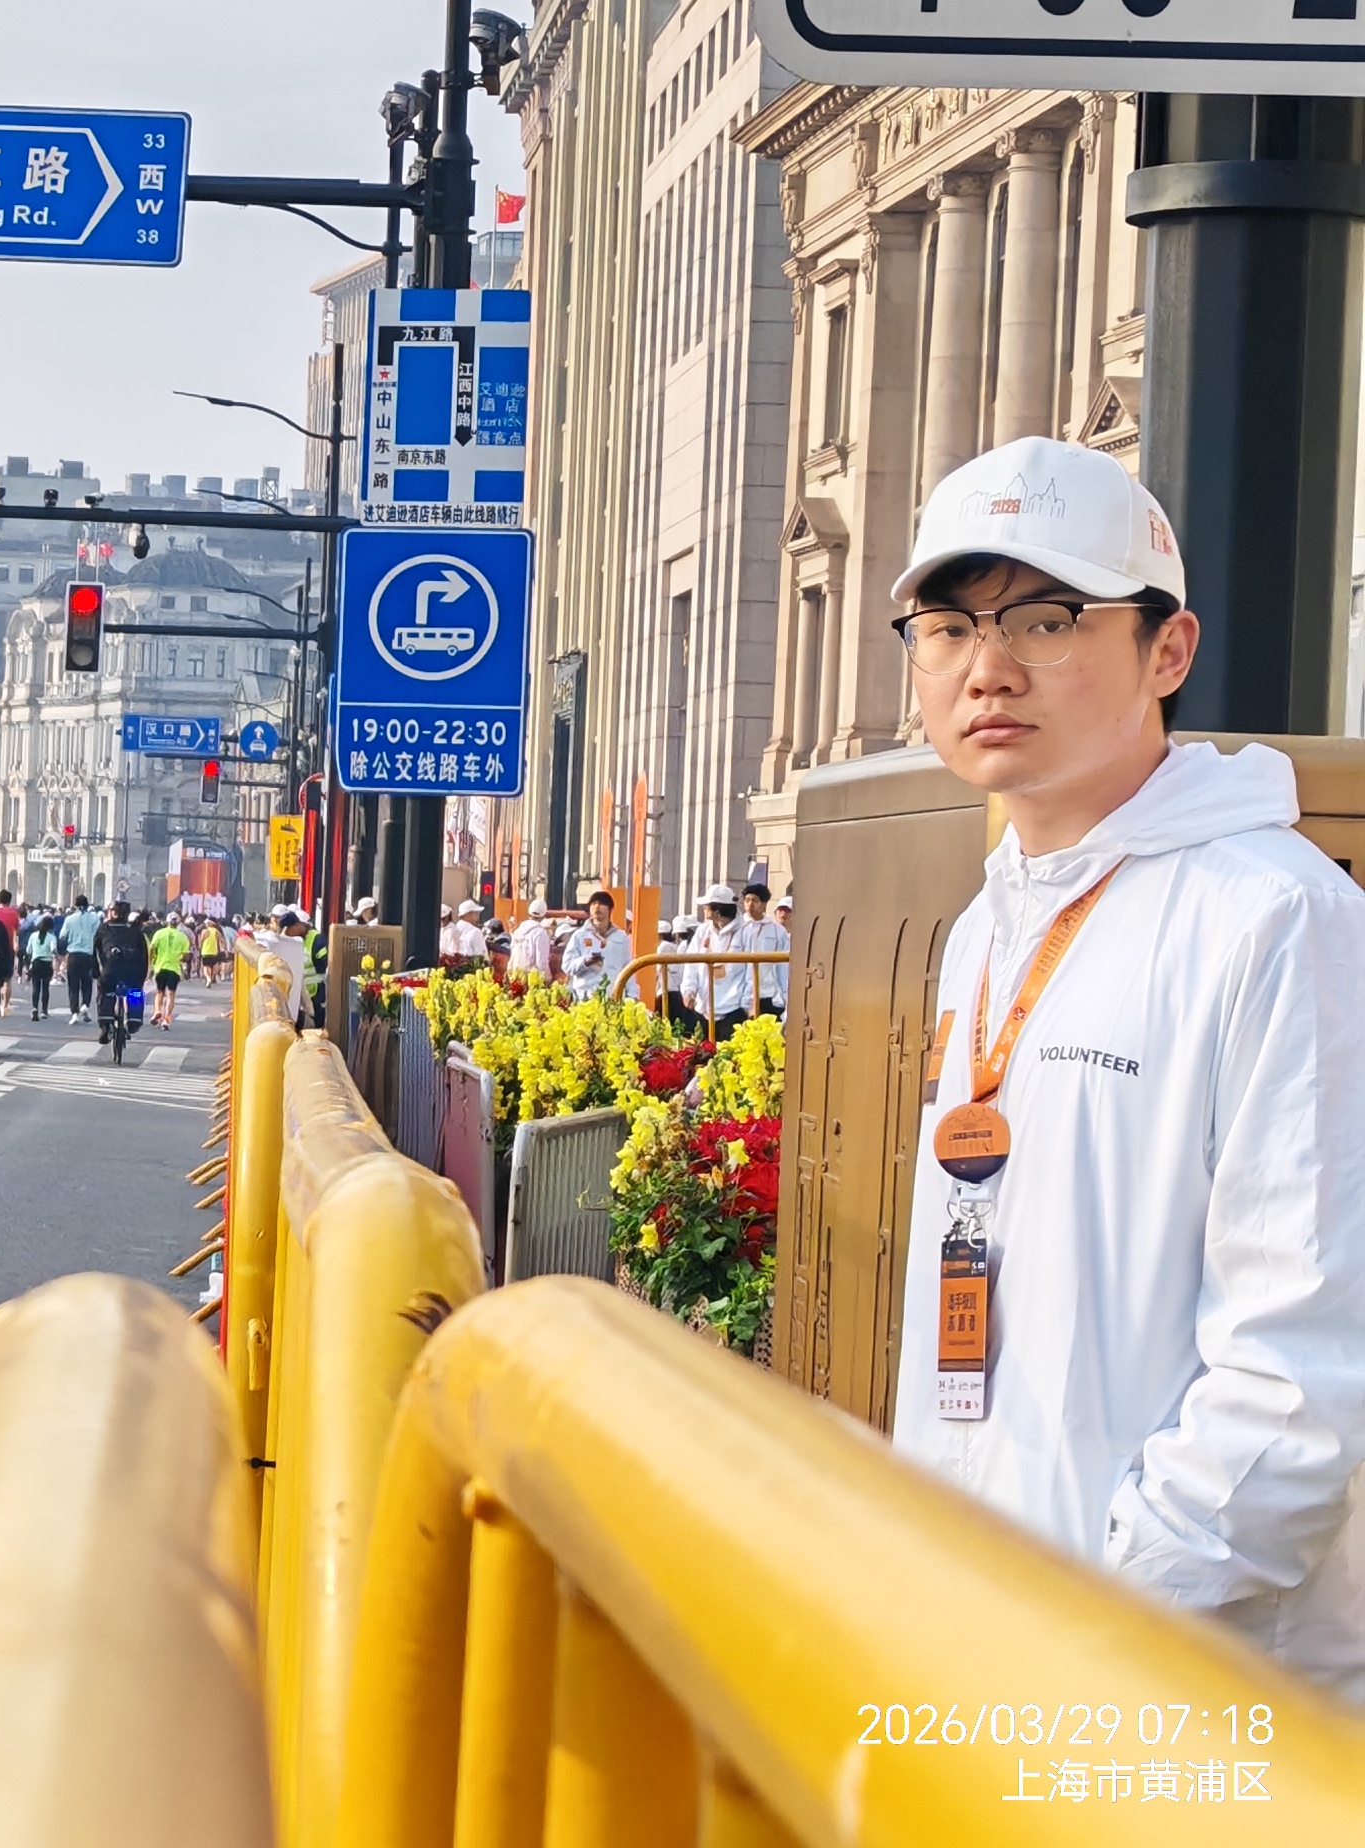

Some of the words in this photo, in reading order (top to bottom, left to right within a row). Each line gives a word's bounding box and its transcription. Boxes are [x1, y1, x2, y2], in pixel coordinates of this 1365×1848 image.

[143, 133, 166, 149] 33
[138, 164, 167, 192] 西
[13, 205, 58, 226] Rd.
[136, 199, 164, 215] W
[136, 229, 159, 244] 38
[402, 327, 454, 342] 九江路
[457, 363, 473, 427] 江西中路
[373, 390, 392, 489] 中山东一路
[397, 449, 446, 466] 南京东路
[352, 718, 507, 746] 19:00-22:30
[350, 751, 504, 784] 除公交线路车外
[1039, 1045, 1140, 1077] VOLUNTEER
